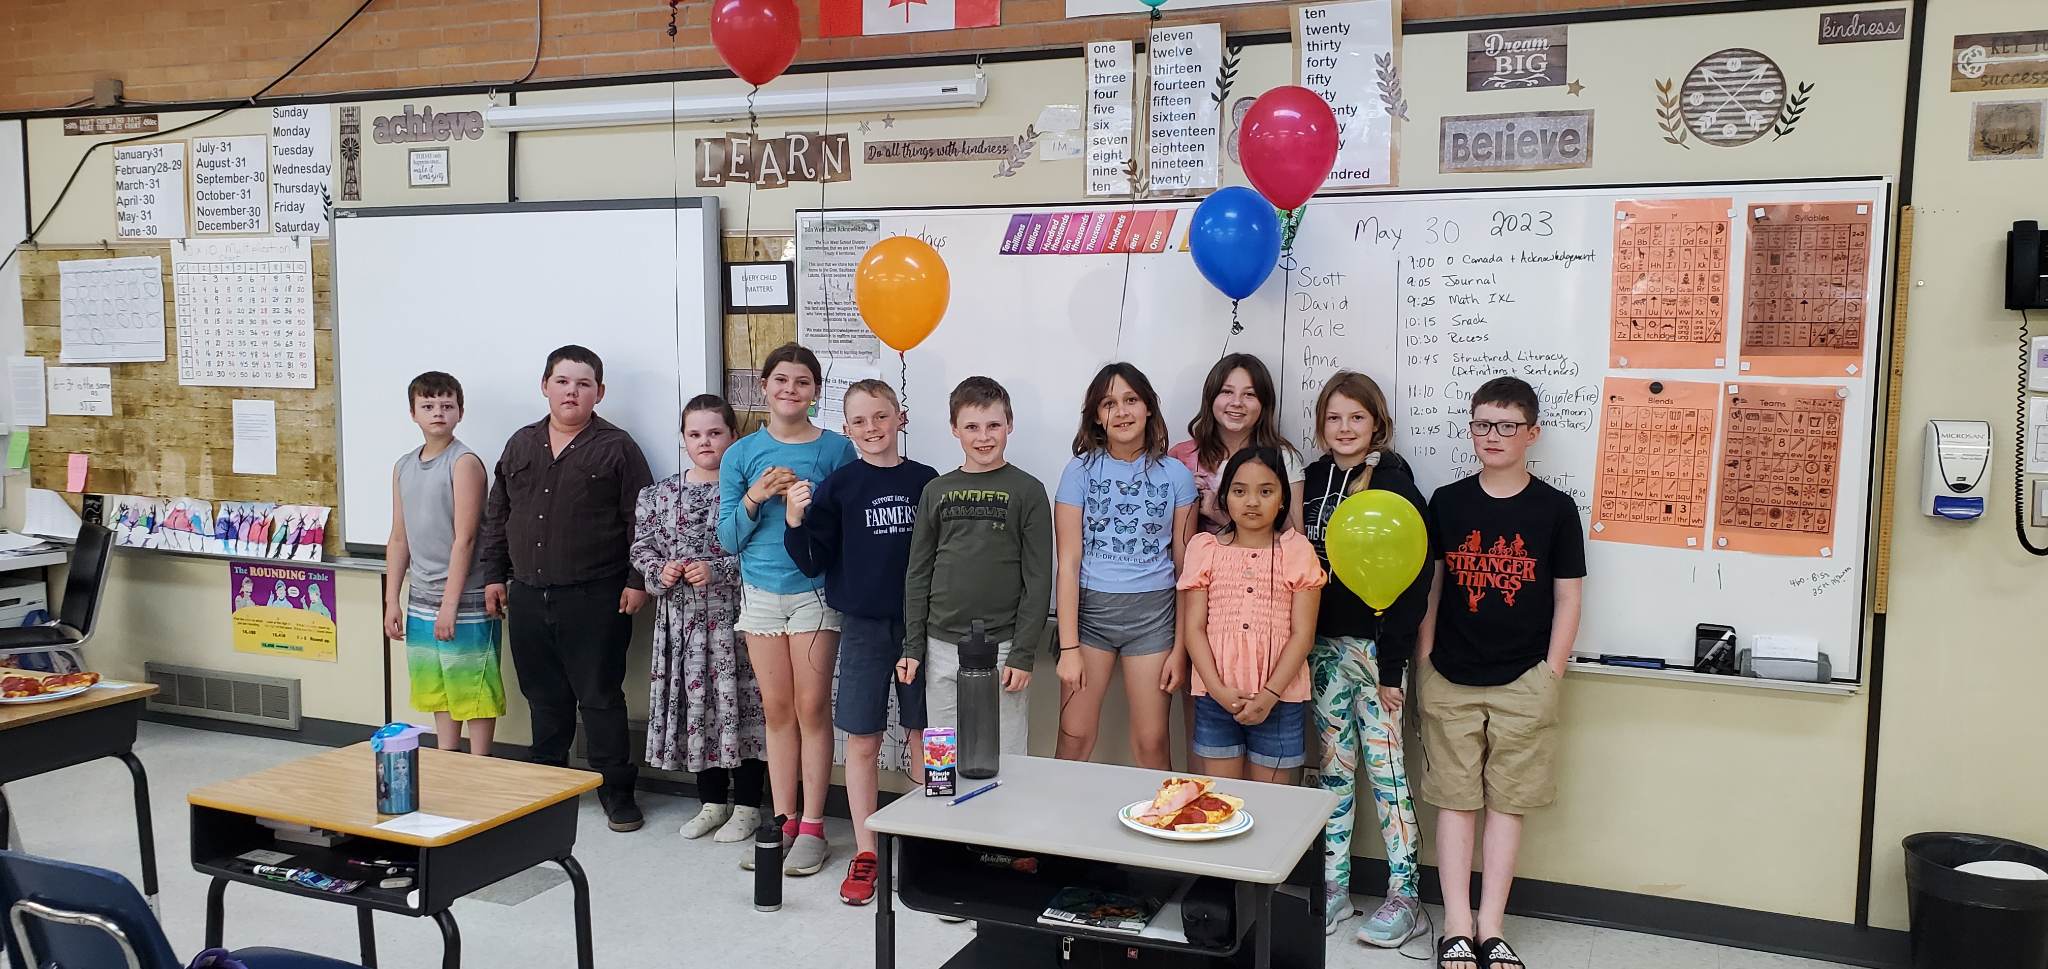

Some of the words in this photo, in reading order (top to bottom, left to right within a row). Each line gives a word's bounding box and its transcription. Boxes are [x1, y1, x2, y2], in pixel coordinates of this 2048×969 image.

[1305, 8, 1326, 19] ten
[1306, 22, 1350, 35] twenty
[1822, 14, 1902, 38] kindness
[1152, 31, 1193, 42] eleven
[1094, 44, 1116, 54] one
[1307, 40, 1342, 52] thirty
[1484, 34, 1550, 56] Dream
[1153, 47, 1193, 58] twelve
[1094, 59, 1116, 68] two
[1307, 56, 1337, 69] forty
[1494, 53, 1548, 76] BIG
[1154, 64, 1202, 75] thirteen
[1095, 73, 1126, 84] three
[1306, 74, 1332, 86] fifty
[1154, 80, 1205, 91] fourteen
[1094, 90, 1118, 100] four
[1153, 96, 1191, 107] fifteen
[272, 107, 309, 119] Sunday
[1093, 104, 1115, 114] five
[1152, 112, 1196, 122] sixteen
[373, 104, 484, 144] achieve
[1093, 120, 1110, 130] six
[273, 126, 310, 138] Monday
[1152, 126, 1216, 138] seventeen
[1093, 136, 1128, 146] seven
[1452, 122, 1580, 162] Believe
[196, 142, 232, 155] July-31
[273, 144, 314, 157] Tuesday
[868, 145, 883, 159] Do
[885, 143, 901, 157] all
[902, 143, 934, 161] things
[936, 142, 960, 157] with
[961, 141, 1008, 156] kindness
[1151, 142, 1205, 155] eighteen
[702, 134, 846, 185] LEARN
[1093, 150, 1123, 163] eight
[196, 157, 246, 170] August-31
[273, 163, 331, 176] Wednesday
[1151, 158, 1204, 169] nineteen
[1092, 166, 1118, 176] nine
[116, 178, 160, 190] March-31
[196, 171, 265, 186] September-30
[1151, 174, 1191, 188] twenty
[273, 182, 319, 195] Thursday
[1092, 181, 1111, 192] ten
[196, 189, 251, 200] October-31
[197, 205, 261, 217] November-30
[274, 201, 305, 214] Friday
[1794, 214, 1830, 223] Syllables
[275, 220, 320, 233] Saturday
[1051, 214, 1070, 251] thousands
[1071, 214, 1090, 251] thousands
[1087, 213, 1106, 251] Thousands
[1108, 214, 1126, 250] Hundreds
[1355, 216, 1402, 250] May
[1426, 216, 1460, 244] 30
[1491, 211, 1553, 236] 2023
[917, 224, 948, 253] days
[1011, 224, 1026, 252] millions
[1026, 223, 1041, 251] Millions
[1042, 219, 1059, 251] Hundred
[1130, 234, 1140, 249] Tens
[1150, 231, 1162, 250] Ones
[1002, 240, 1011, 252] Ten
[1462, 255, 1503, 264] Canada
[1298, 267, 1347, 287] Scott
[1407, 277, 1431, 287] 9:05
[1442, 273, 1497, 287] Journal
[1294, 292, 1348, 312] David
[1407, 295, 1436, 307] 9:25
[1489, 293, 1516, 304] IXL
[1302, 319, 1346, 337] Kale
[1406, 316, 1437, 328] 10:15
[1452, 315, 1488, 327] Snack
[1406, 334, 1438, 346] 10:30
[1448, 331, 1489, 343] Recess
[1304, 345, 1339, 368] Anna
[1407, 353, 1438, 365] 10:45
[1452, 352, 1511, 362] Structured
[1518, 350, 1568, 367] Literacy
[1409, 384, 1434, 398] 11:10
[1410, 407, 1438, 415] 12:00
[1411, 424, 1440, 435] 12:45
[865, 505, 918, 528] FARMERS
[1446, 554, 1537, 580] STRANGER
[249, 567, 305, 580] ROUNDING
[308, 573, 328, 581] Table
[1456, 570, 1522, 591] THINGS
[1443, 951, 1476, 960] adidas
